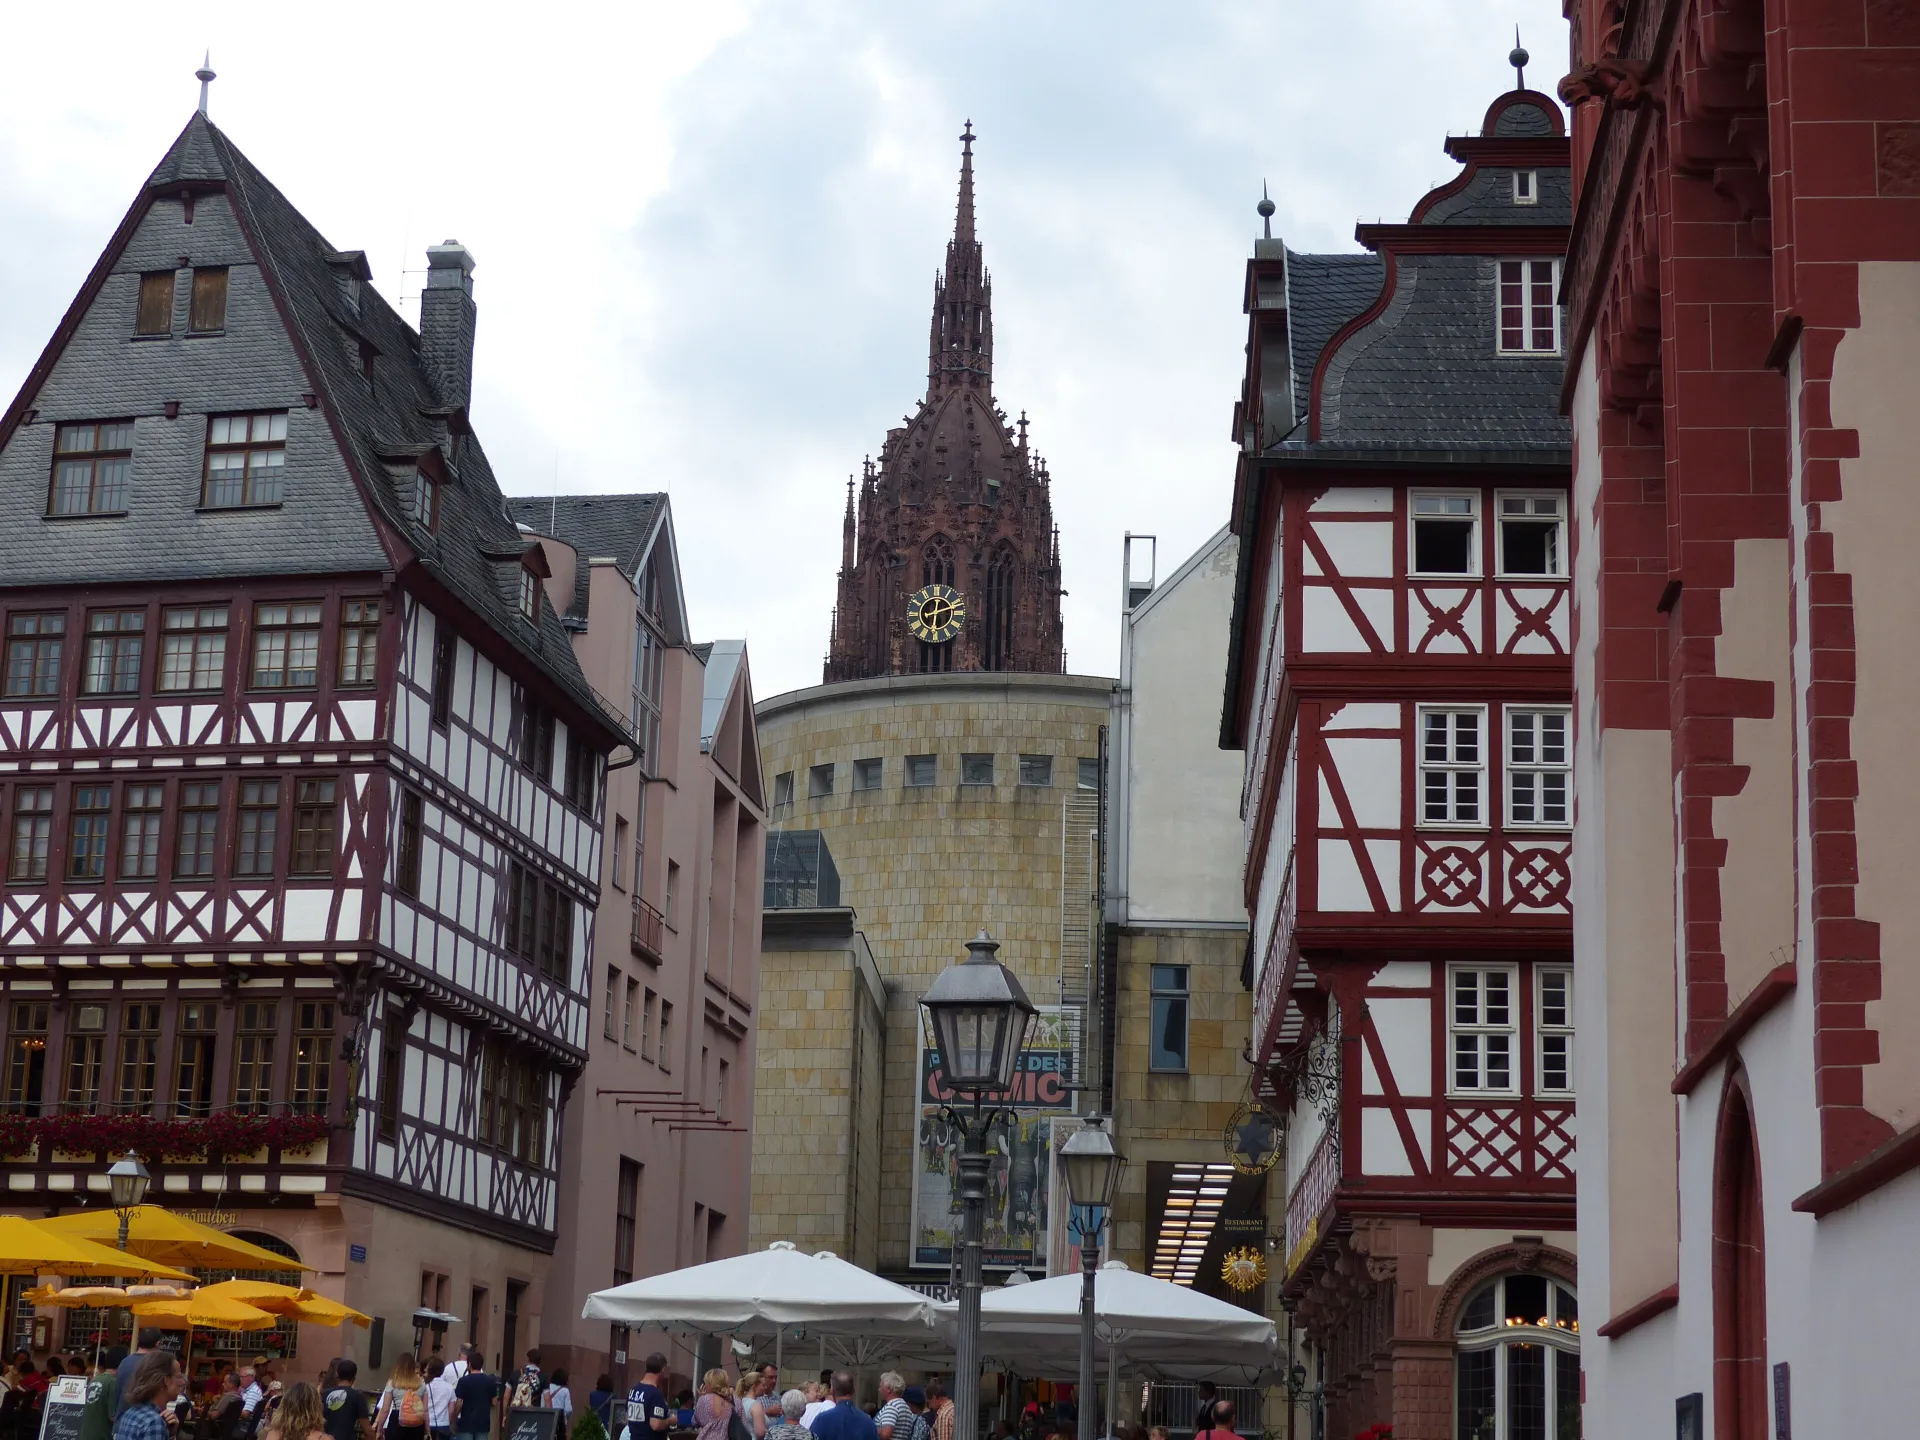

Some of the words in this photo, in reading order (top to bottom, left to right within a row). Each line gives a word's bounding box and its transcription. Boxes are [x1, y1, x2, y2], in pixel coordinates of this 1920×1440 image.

[1028, 1056, 1067, 1071] DES
[928, 1070, 1066, 1103] CMIC
[1224, 1218, 1264, 1226] RESTAURANT
